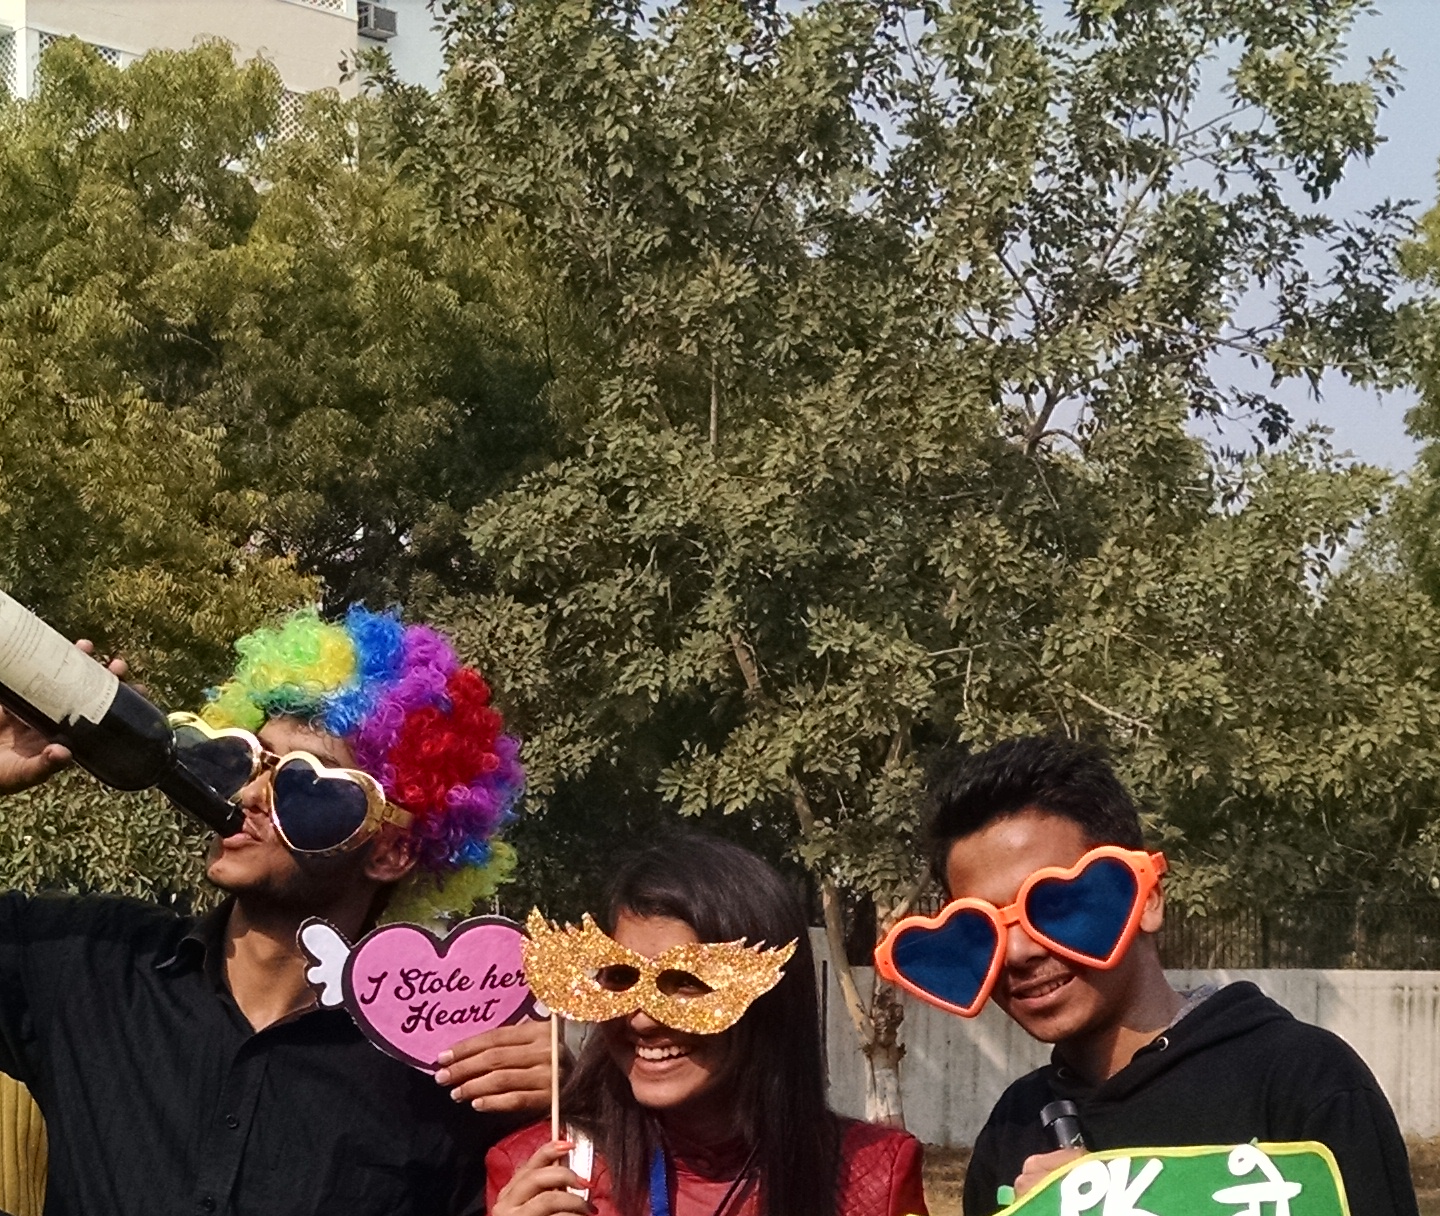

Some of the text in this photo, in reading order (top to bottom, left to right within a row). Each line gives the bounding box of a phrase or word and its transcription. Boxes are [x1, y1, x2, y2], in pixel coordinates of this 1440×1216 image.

[360, 963, 529, 1005] I Stole her
[400, 998, 501, 1034] Heart
